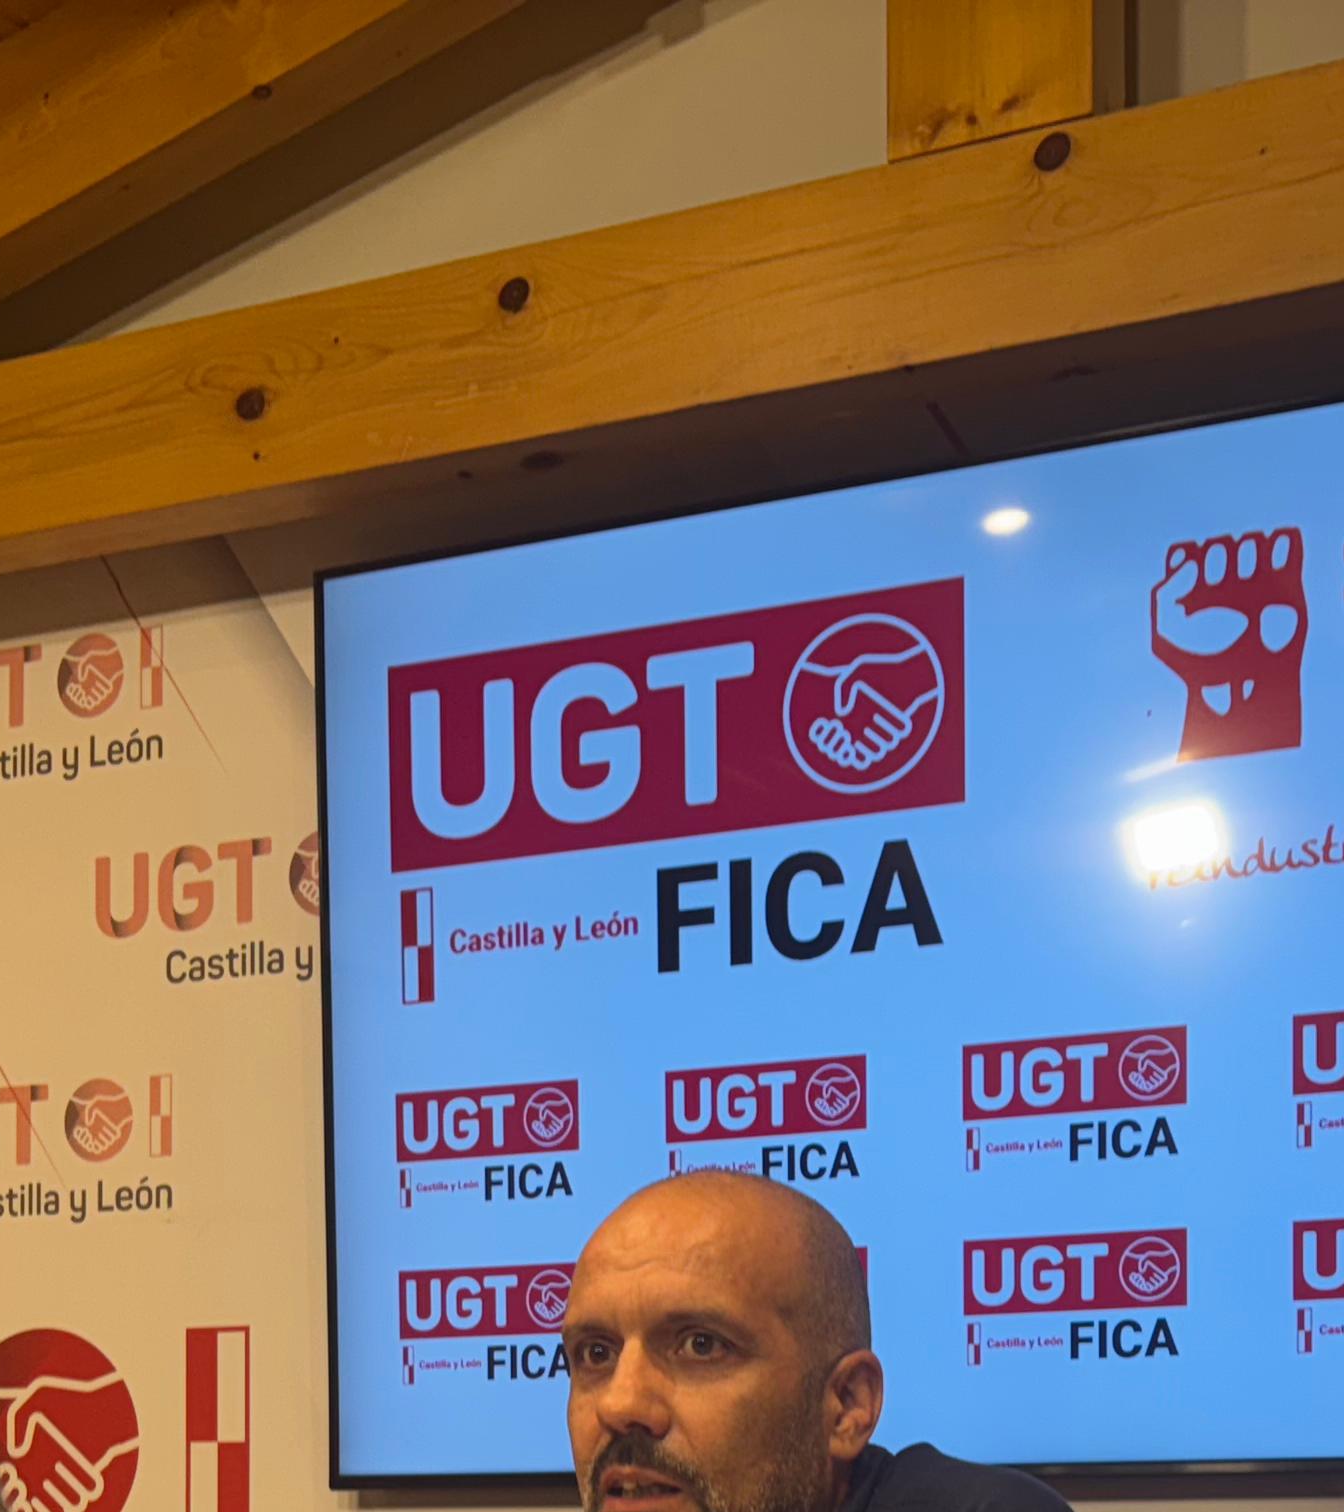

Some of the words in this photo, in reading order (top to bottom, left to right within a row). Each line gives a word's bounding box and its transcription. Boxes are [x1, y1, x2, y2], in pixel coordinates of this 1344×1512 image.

[60, 742, 81, 780] y
[88, 729, 165, 770] León
[409, 640, 756, 840] UGT
[94, 836, 273, 940] UGT
[656, 837, 945, 974] FICA
[449, 922, 546, 954] Castilla
[552, 921, 568, 950] y
[575, 910, 640, 942] León
[165, 939, 285, 984] Castilla
[294, 944, 314, 982] y
[672, 1070, 797, 1135] UGT
[971, 1042, 1109, 1112] UGT
[402, 1093, 516, 1155] UGT
[1069, 1116, 1179, 1163] FICA
[484, 1161, 574, 1202] FICA
[761, 1140, 860, 1182] FICA
[68, 1187, 89, 1225] y
[95, 1176, 174, 1215] León
[971, 1241, 1110, 1308] UGT
[405, 1274, 519, 1333] UGT
[486, 1343, 571, 1381] FICA
[1069, 1317, 1179, 1361] FICA
